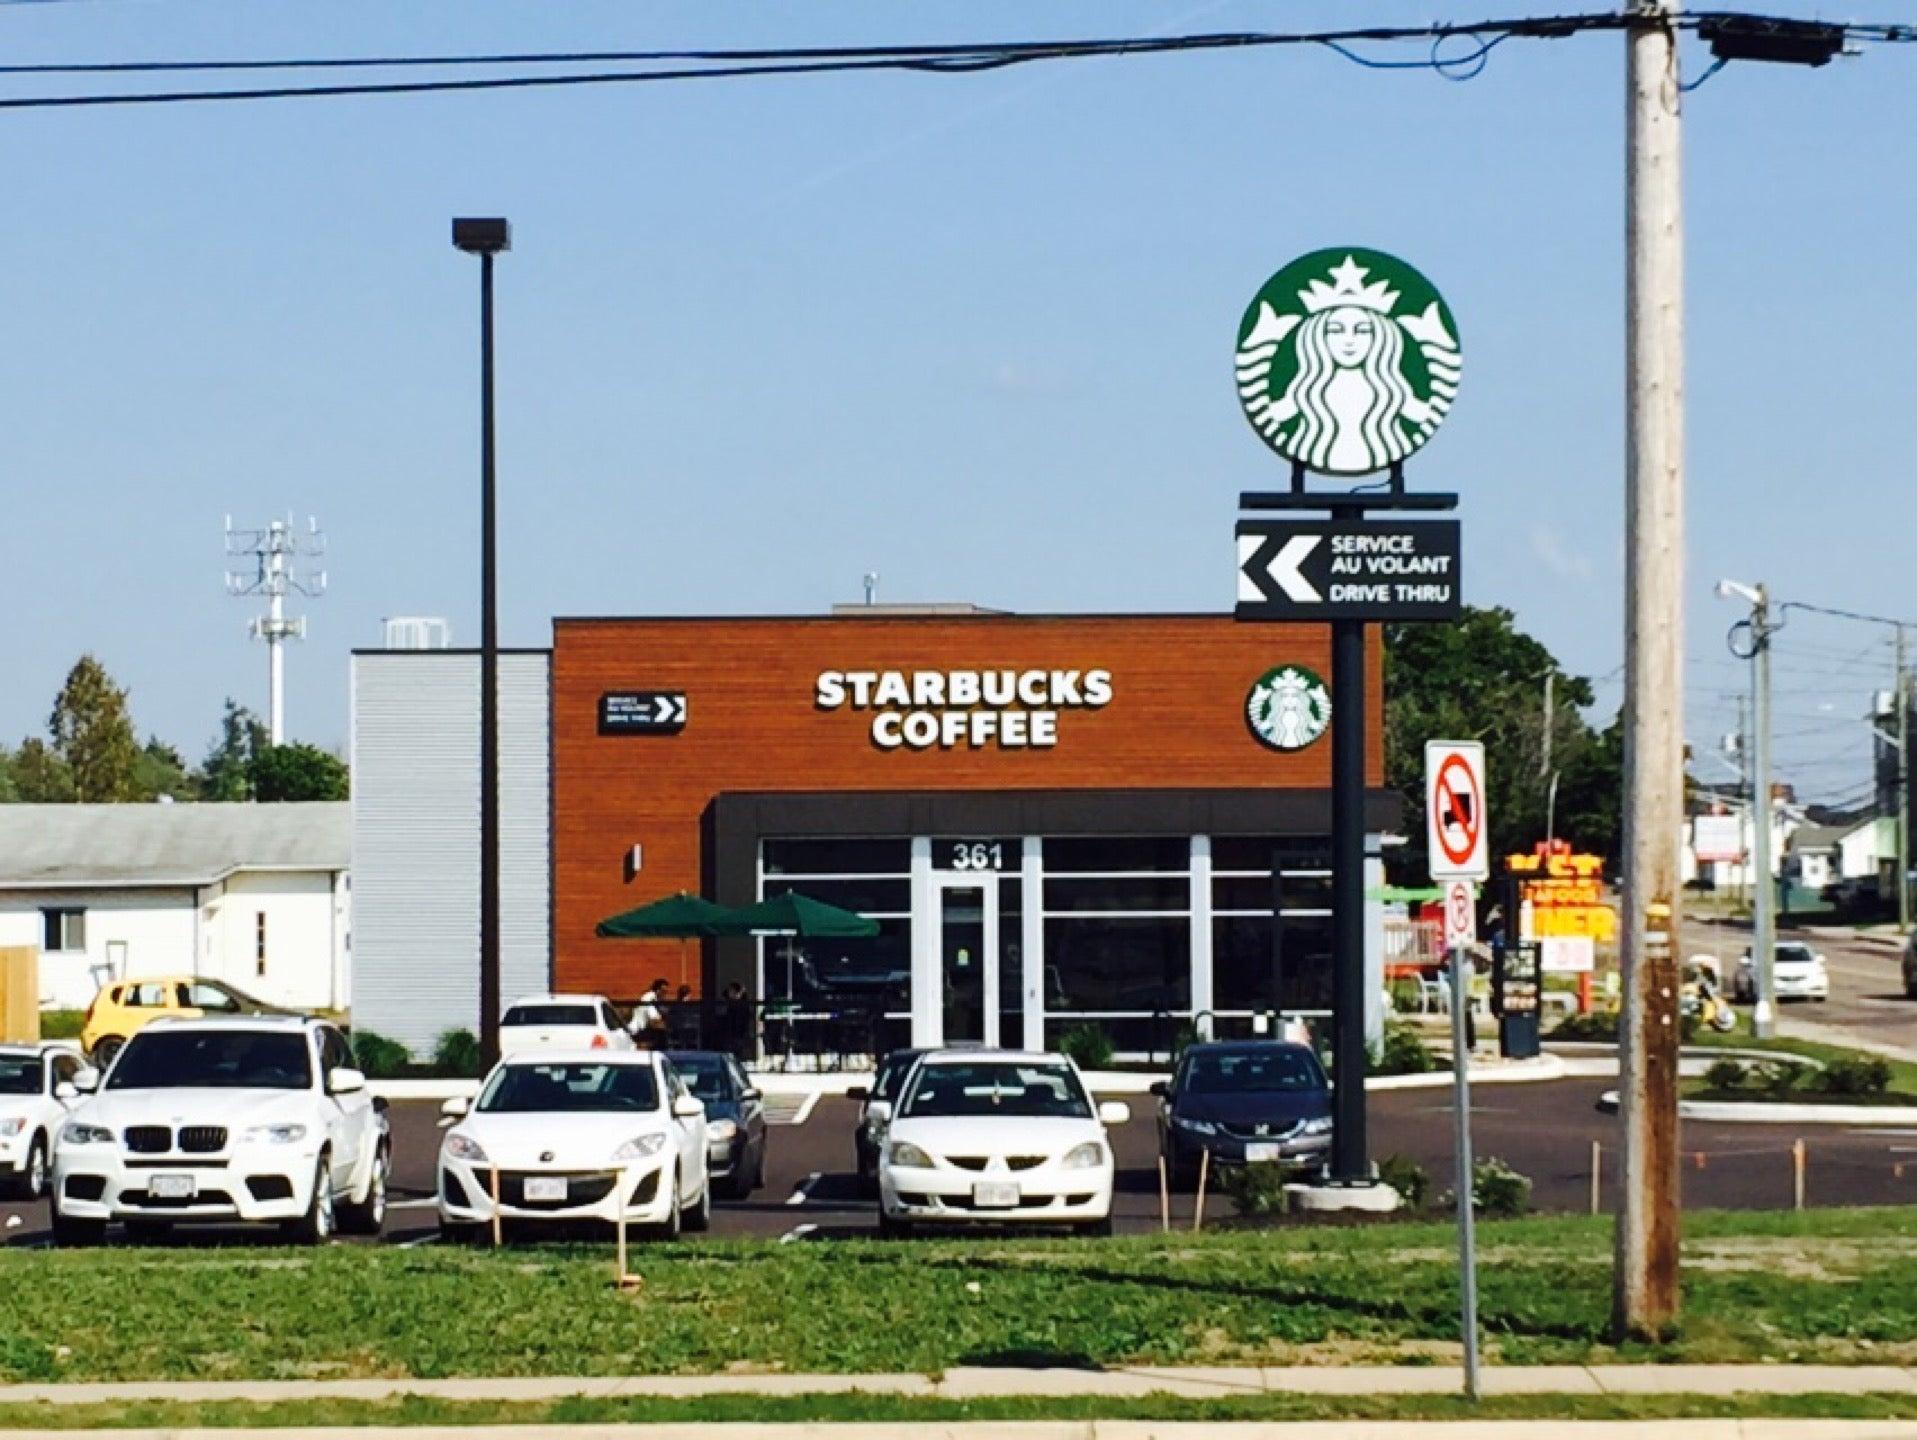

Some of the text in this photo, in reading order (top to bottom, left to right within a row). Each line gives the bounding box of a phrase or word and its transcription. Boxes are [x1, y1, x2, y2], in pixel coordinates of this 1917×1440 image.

[1331, 535, 1415, 553] SERVICE
[1330, 556, 1451, 573] AU VOLANT
[1329, 584, 1450, 601] DRIVE THRU
[816, 670, 1113, 706] STARBUCKS
[872, 711, 1058, 746] COFFEE
[952, 843, 1002, 869] 361
